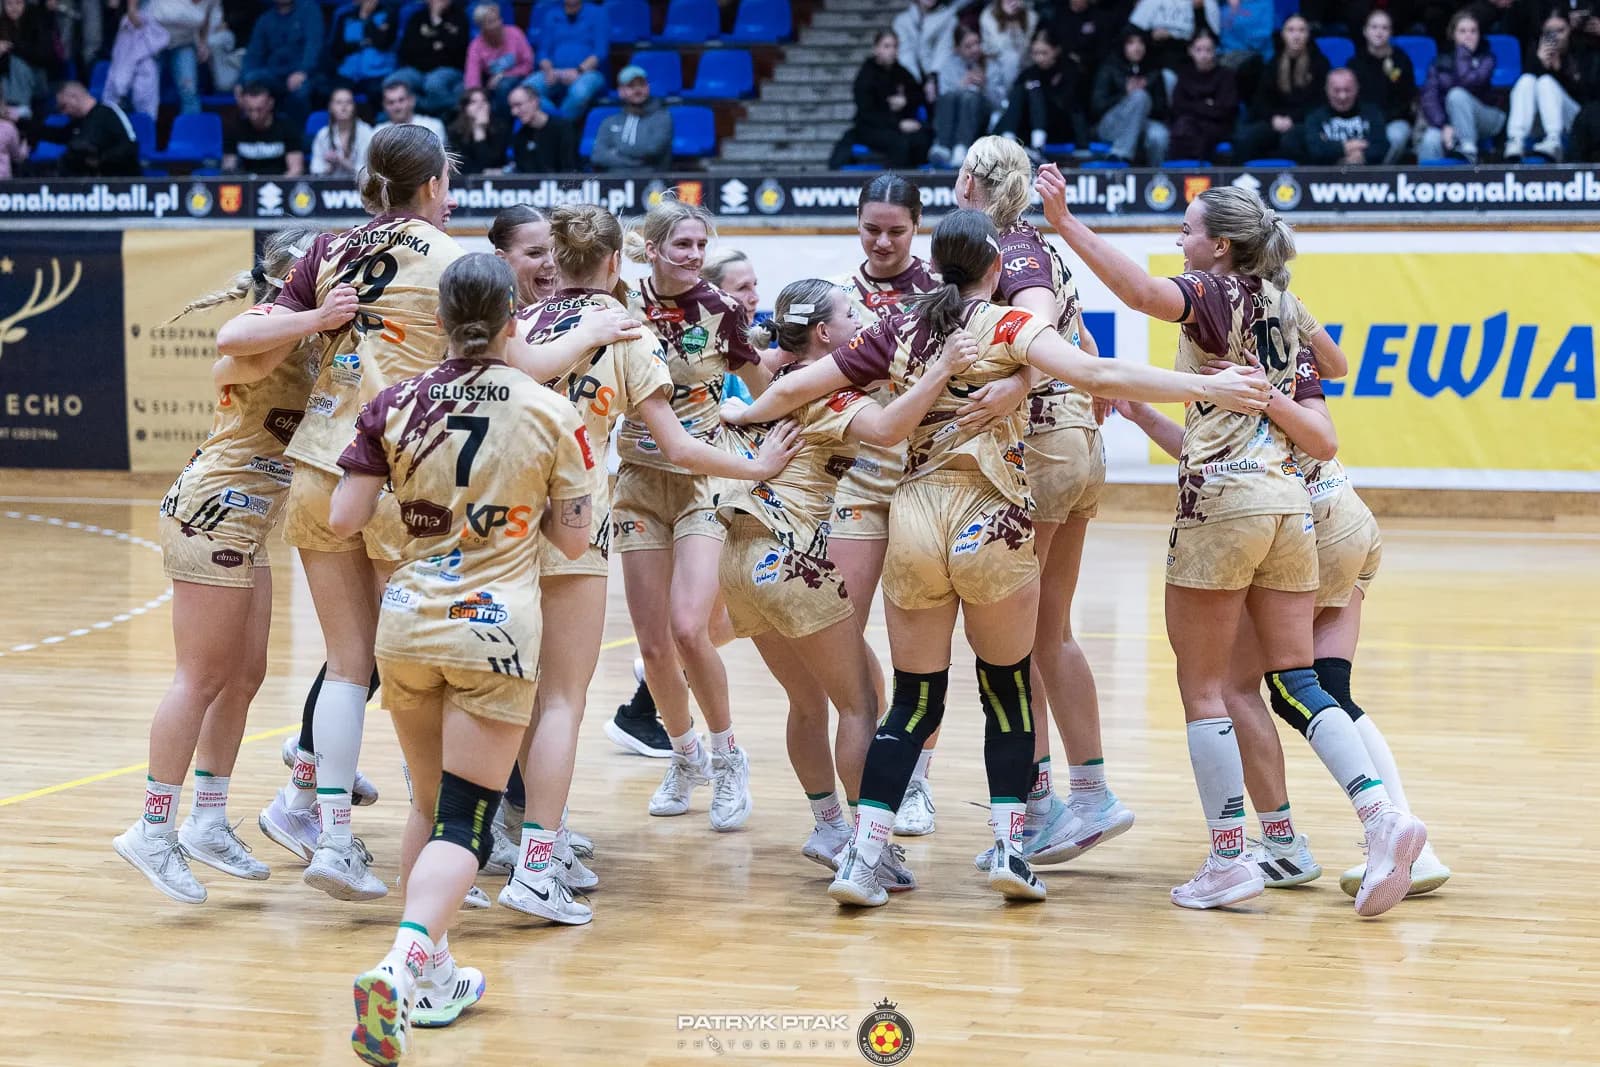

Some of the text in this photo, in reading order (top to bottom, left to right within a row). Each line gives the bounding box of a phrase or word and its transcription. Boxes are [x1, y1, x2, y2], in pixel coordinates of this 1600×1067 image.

[1004, 256, 1040, 271] KPS
[1251, 317, 1290, 375] 10
[429, 383, 510, 402] GŁUSZKO
[5, 393, 84, 416] ECHO
[446, 415, 490, 488] 7
[465, 503, 532, 538] KPS
[835, 506, 863, 520] KPS
